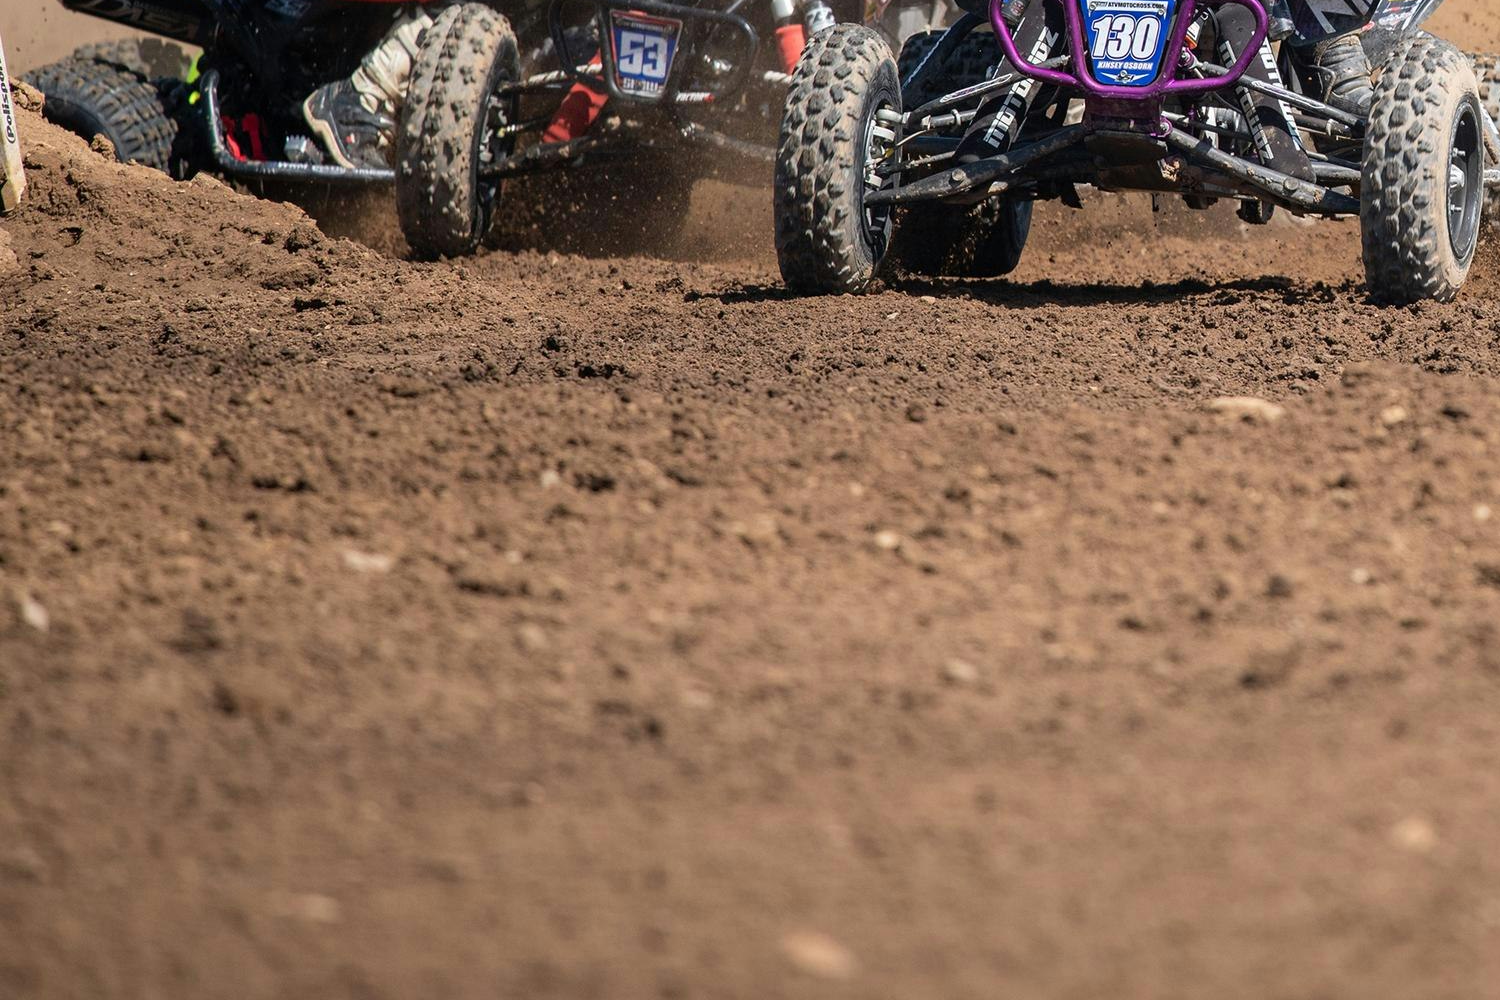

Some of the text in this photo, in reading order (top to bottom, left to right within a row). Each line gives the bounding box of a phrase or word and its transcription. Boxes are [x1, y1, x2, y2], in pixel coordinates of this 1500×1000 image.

[619, 31, 667, 79] 53
[1092, 14, 1161, 60] 130
[1097, 61, 1154, 70] KINSEY OSBORN
